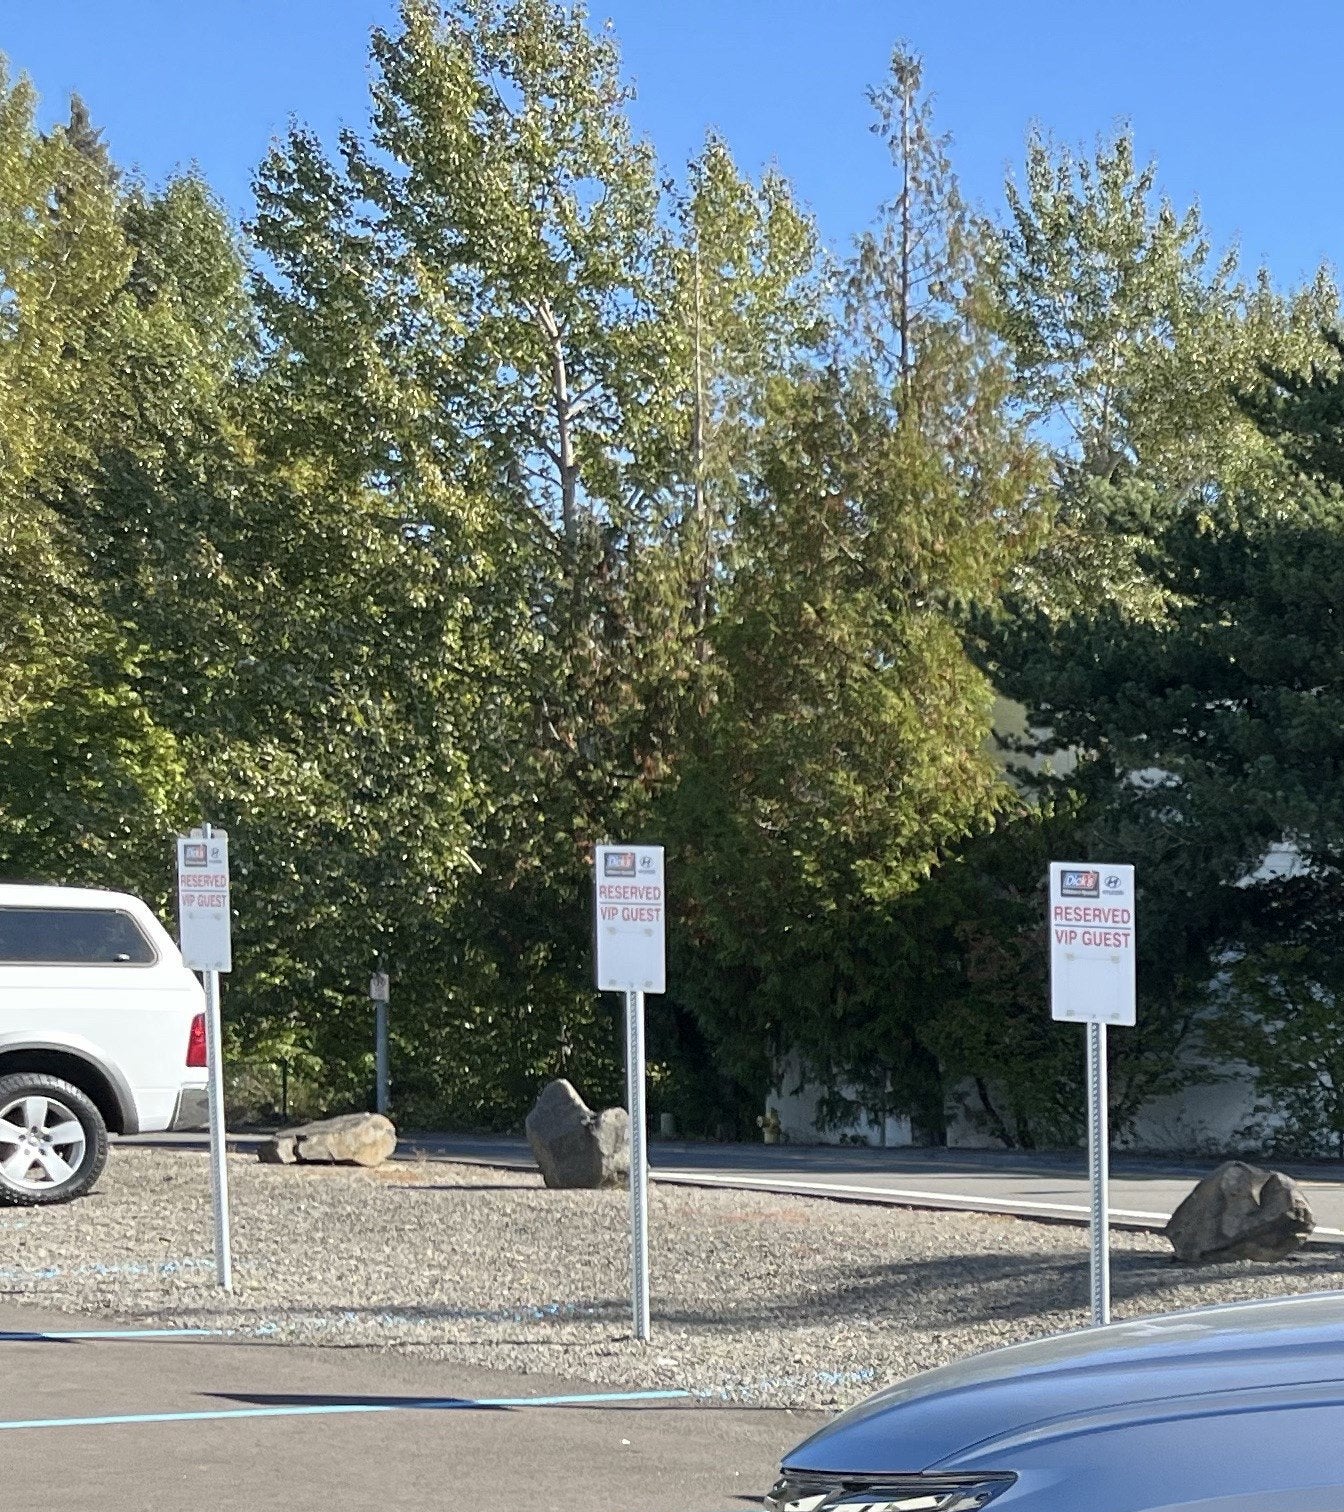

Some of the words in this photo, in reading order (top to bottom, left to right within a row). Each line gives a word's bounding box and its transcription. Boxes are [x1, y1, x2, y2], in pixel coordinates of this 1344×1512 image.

[180, 874, 227, 888] RESERVED
[599, 885, 661, 900] RESERVED
[600, 906, 618, 920] VIP
[621, 907, 661, 922] GUEST
[1054, 906, 1131, 924] RESERVED
[1055, 929, 1077, 945] VIP
[1082, 930, 1131, 948] GUEST
